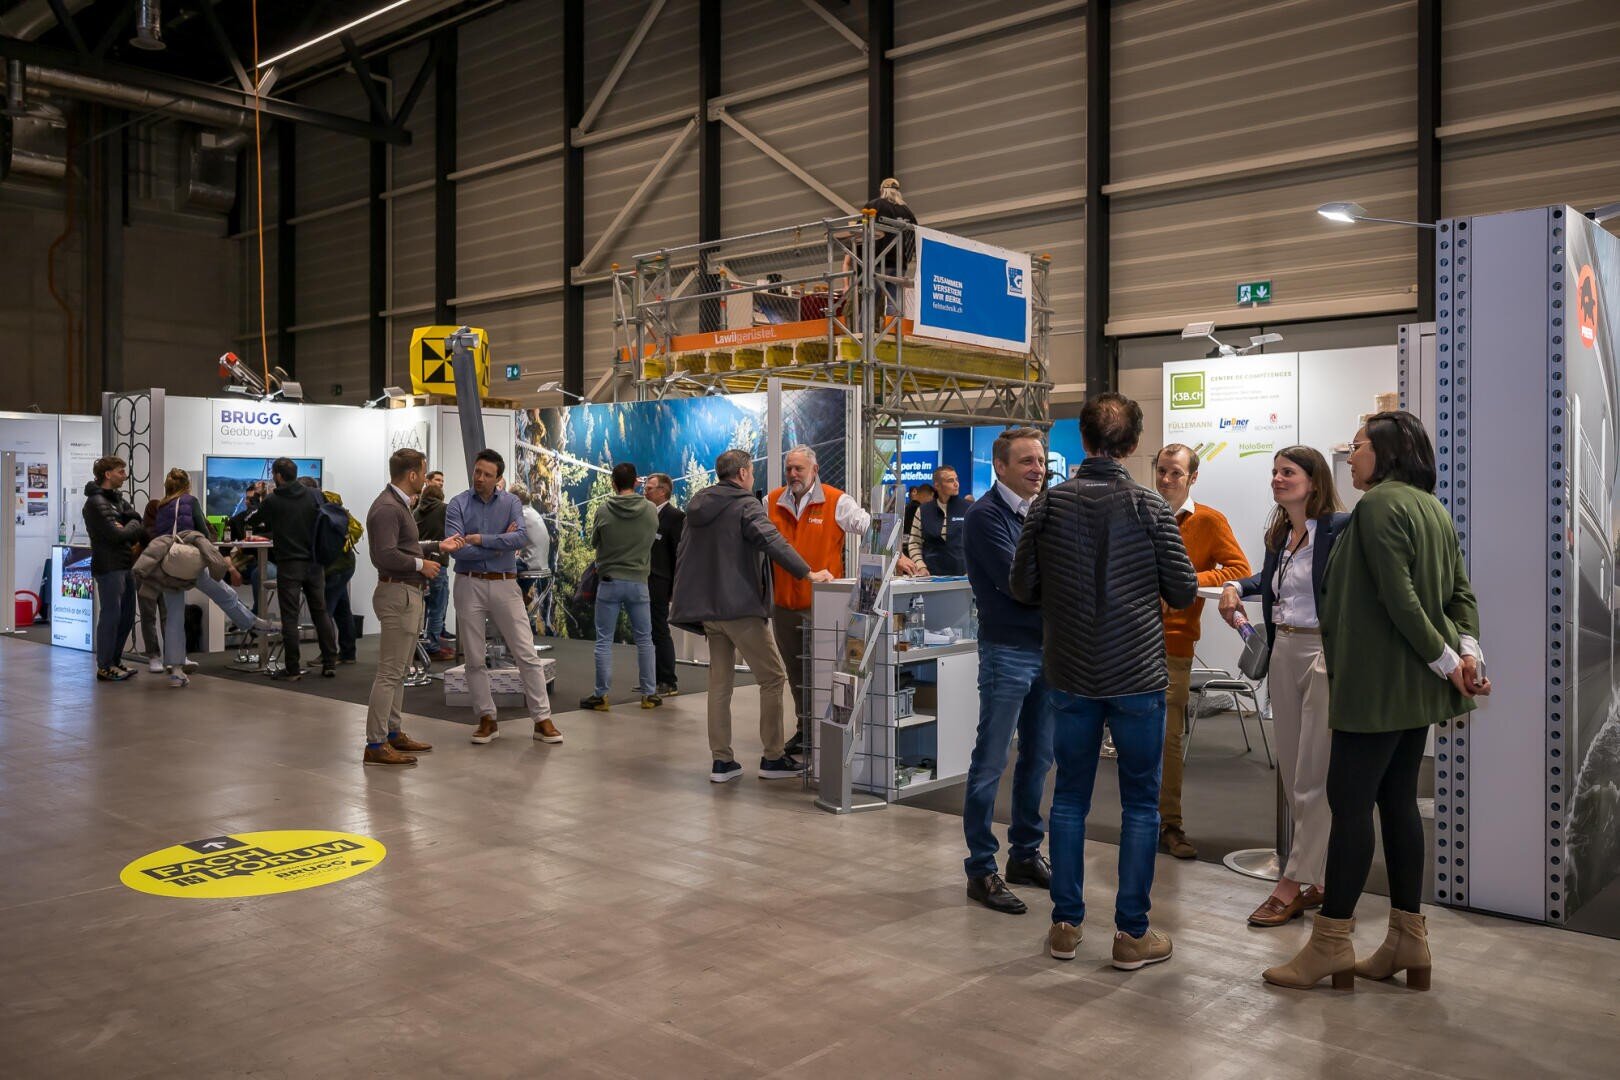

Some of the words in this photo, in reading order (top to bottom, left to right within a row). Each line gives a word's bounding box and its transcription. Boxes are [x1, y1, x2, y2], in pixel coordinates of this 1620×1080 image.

[933, 274, 963, 289] ZUSAMMEN
[932, 291, 944, 301] WIR
[933, 284, 962, 297] VERSETZEN
[221, 410, 281, 425] BRUGG
[220, 425, 273, 440] Geobrugg
[892, 461, 921, 471] Eperte
[921, 461, 932, 470] im
[151, 849, 268, 877] FACH
[213, 841, 354, 877] FORUM
[275, 860, 346, 878] BRUGG
